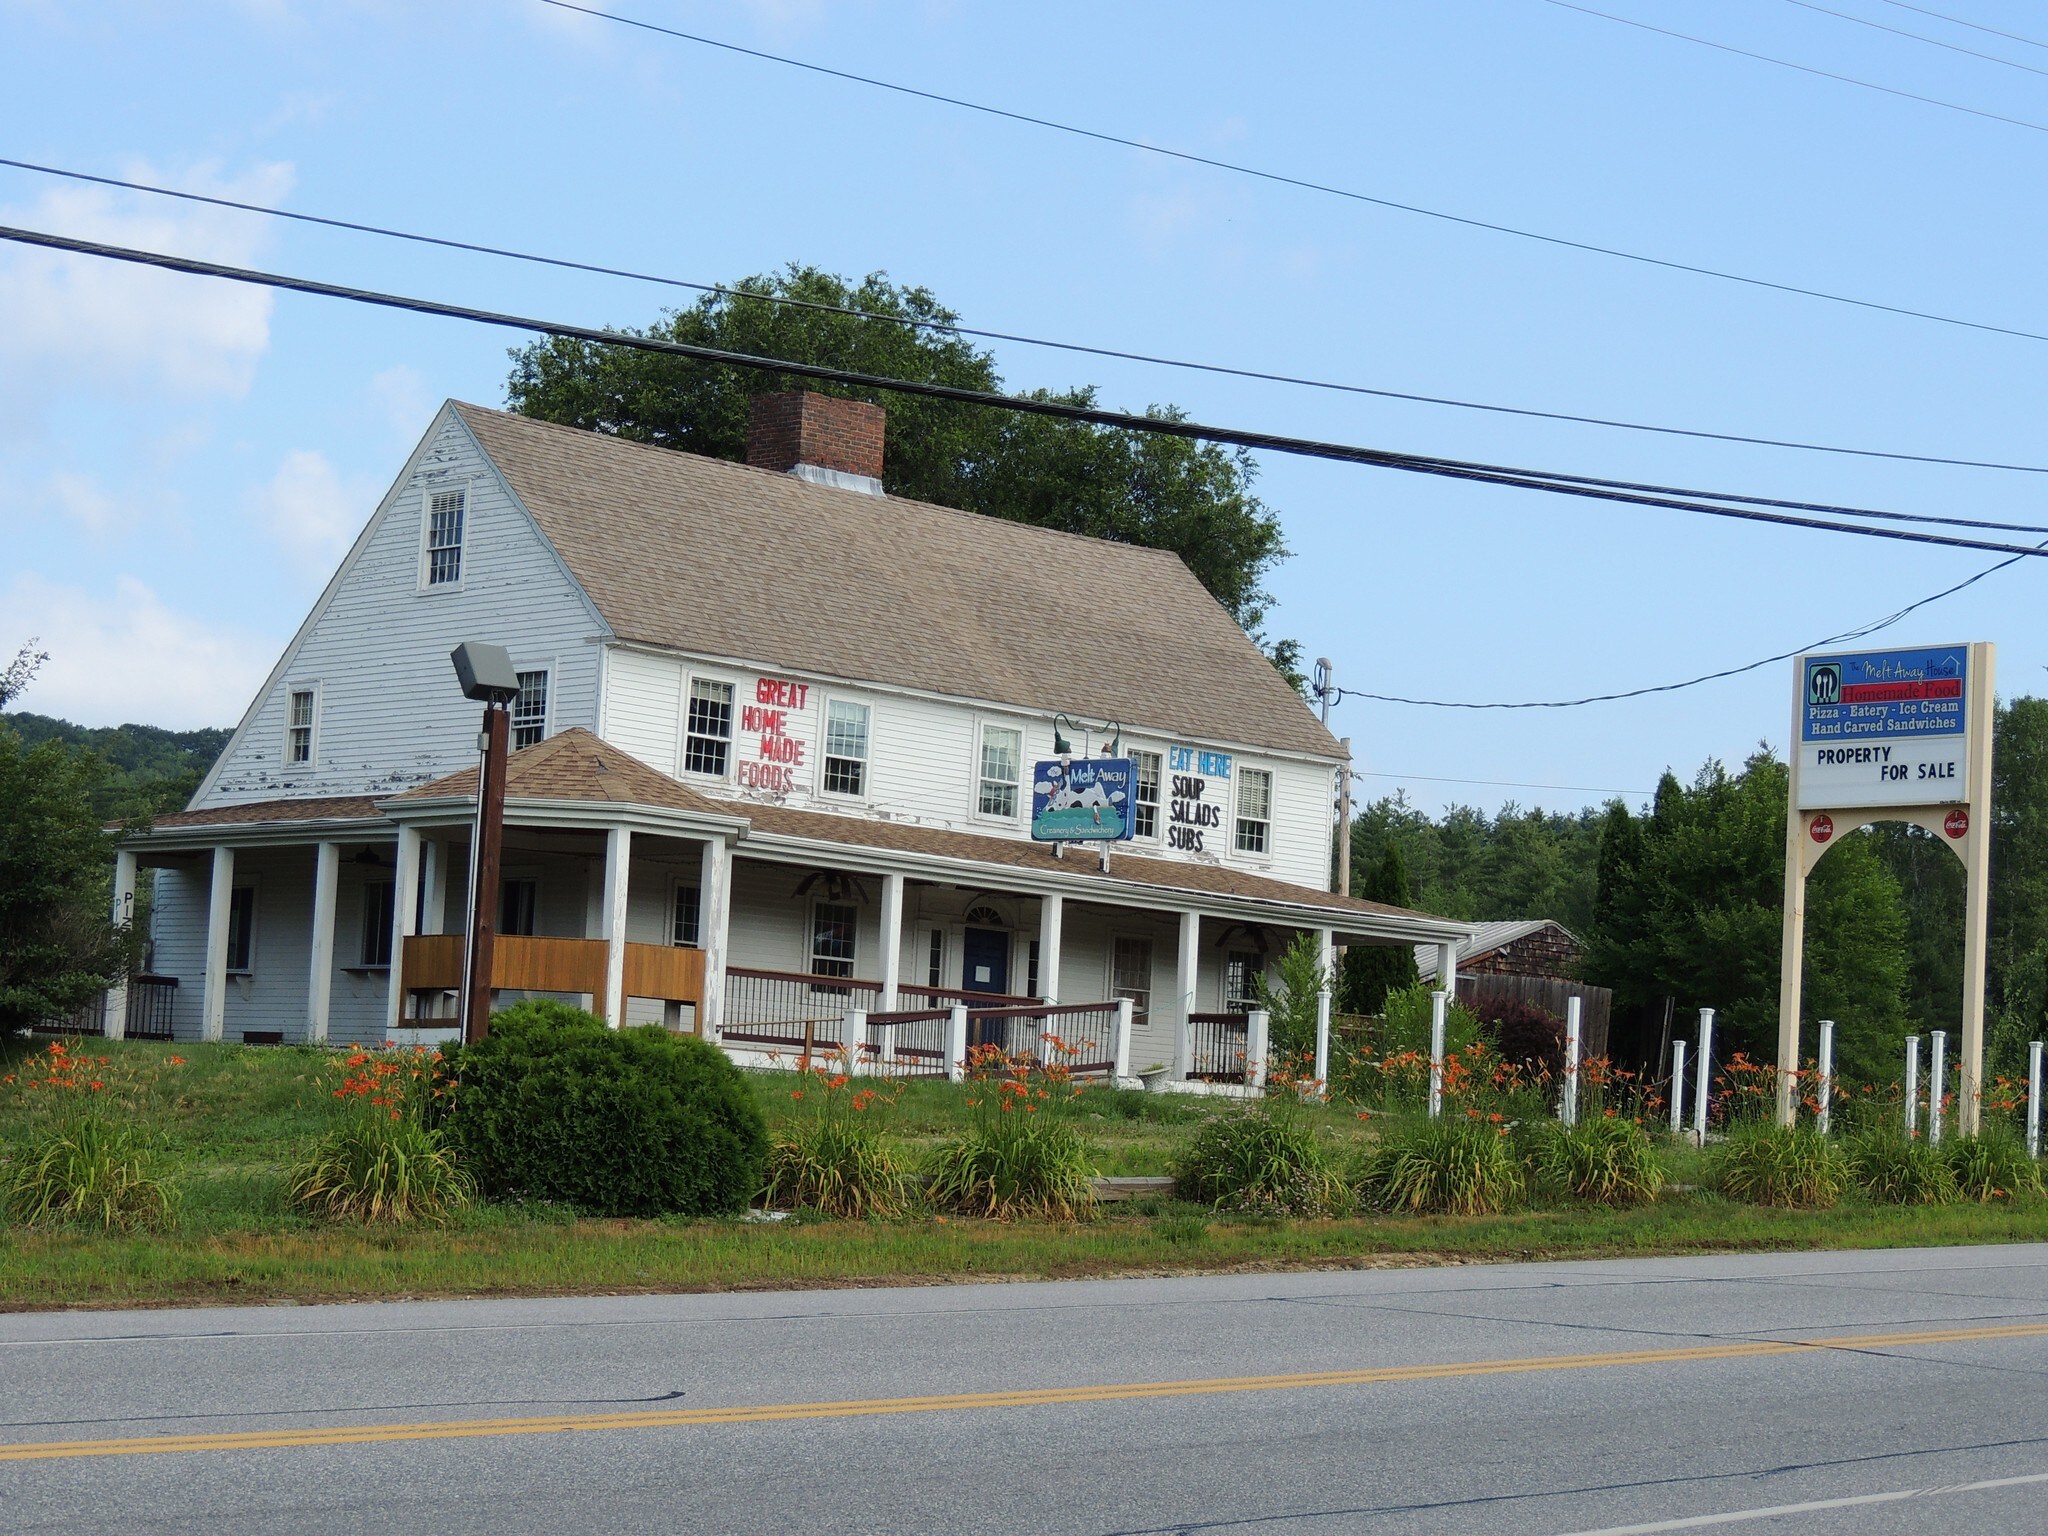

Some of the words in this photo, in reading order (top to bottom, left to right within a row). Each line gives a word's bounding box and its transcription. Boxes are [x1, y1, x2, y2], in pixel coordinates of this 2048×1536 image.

[1861, 659, 1893, 680] Melt
[1893, 661, 1925, 685] Away
[1926, 659, 1954, 677] House
[756, 678, 809, 710] GREAT
[1842, 684, 1920, 704] Homemade
[1923, 680, 1960, 700] Food
[741, 705, 788, 736] HOME
[1809, 706, 1840, 719] Pizza
[1850, 704, 1889, 719] Eatery
[1899, 702, 1918, 714] Ice
[1921, 701, 1959, 713] Cream
[1811, 721, 1841, 735] Hand
[1844, 719, 1884, 733] Carved
[1887, 716, 1956, 731] Sandwiches
[760, 734, 805, 766] MADE
[1169, 745, 1194, 772] EAT
[1197, 750, 1232, 779] HERE
[1817, 746, 1892, 765] PROPERTY
[738, 760, 794, 792] FOODS
[1070, 763, 1096, 785] Melt
[1095, 768, 1127, 789] Away
[1881, 764, 1909, 781] FOR
[1918, 762, 1955, 779] SALE
[1171, 774, 1205, 800] SOUP
[1169, 799, 1221, 828] SALADS
[1040, 824, 1070, 837] Creamery
[1074, 824, 1114, 836] Sandwichery
[1168, 825, 1204, 853] SUBS
[121, 892, 133, 930] PIZ
